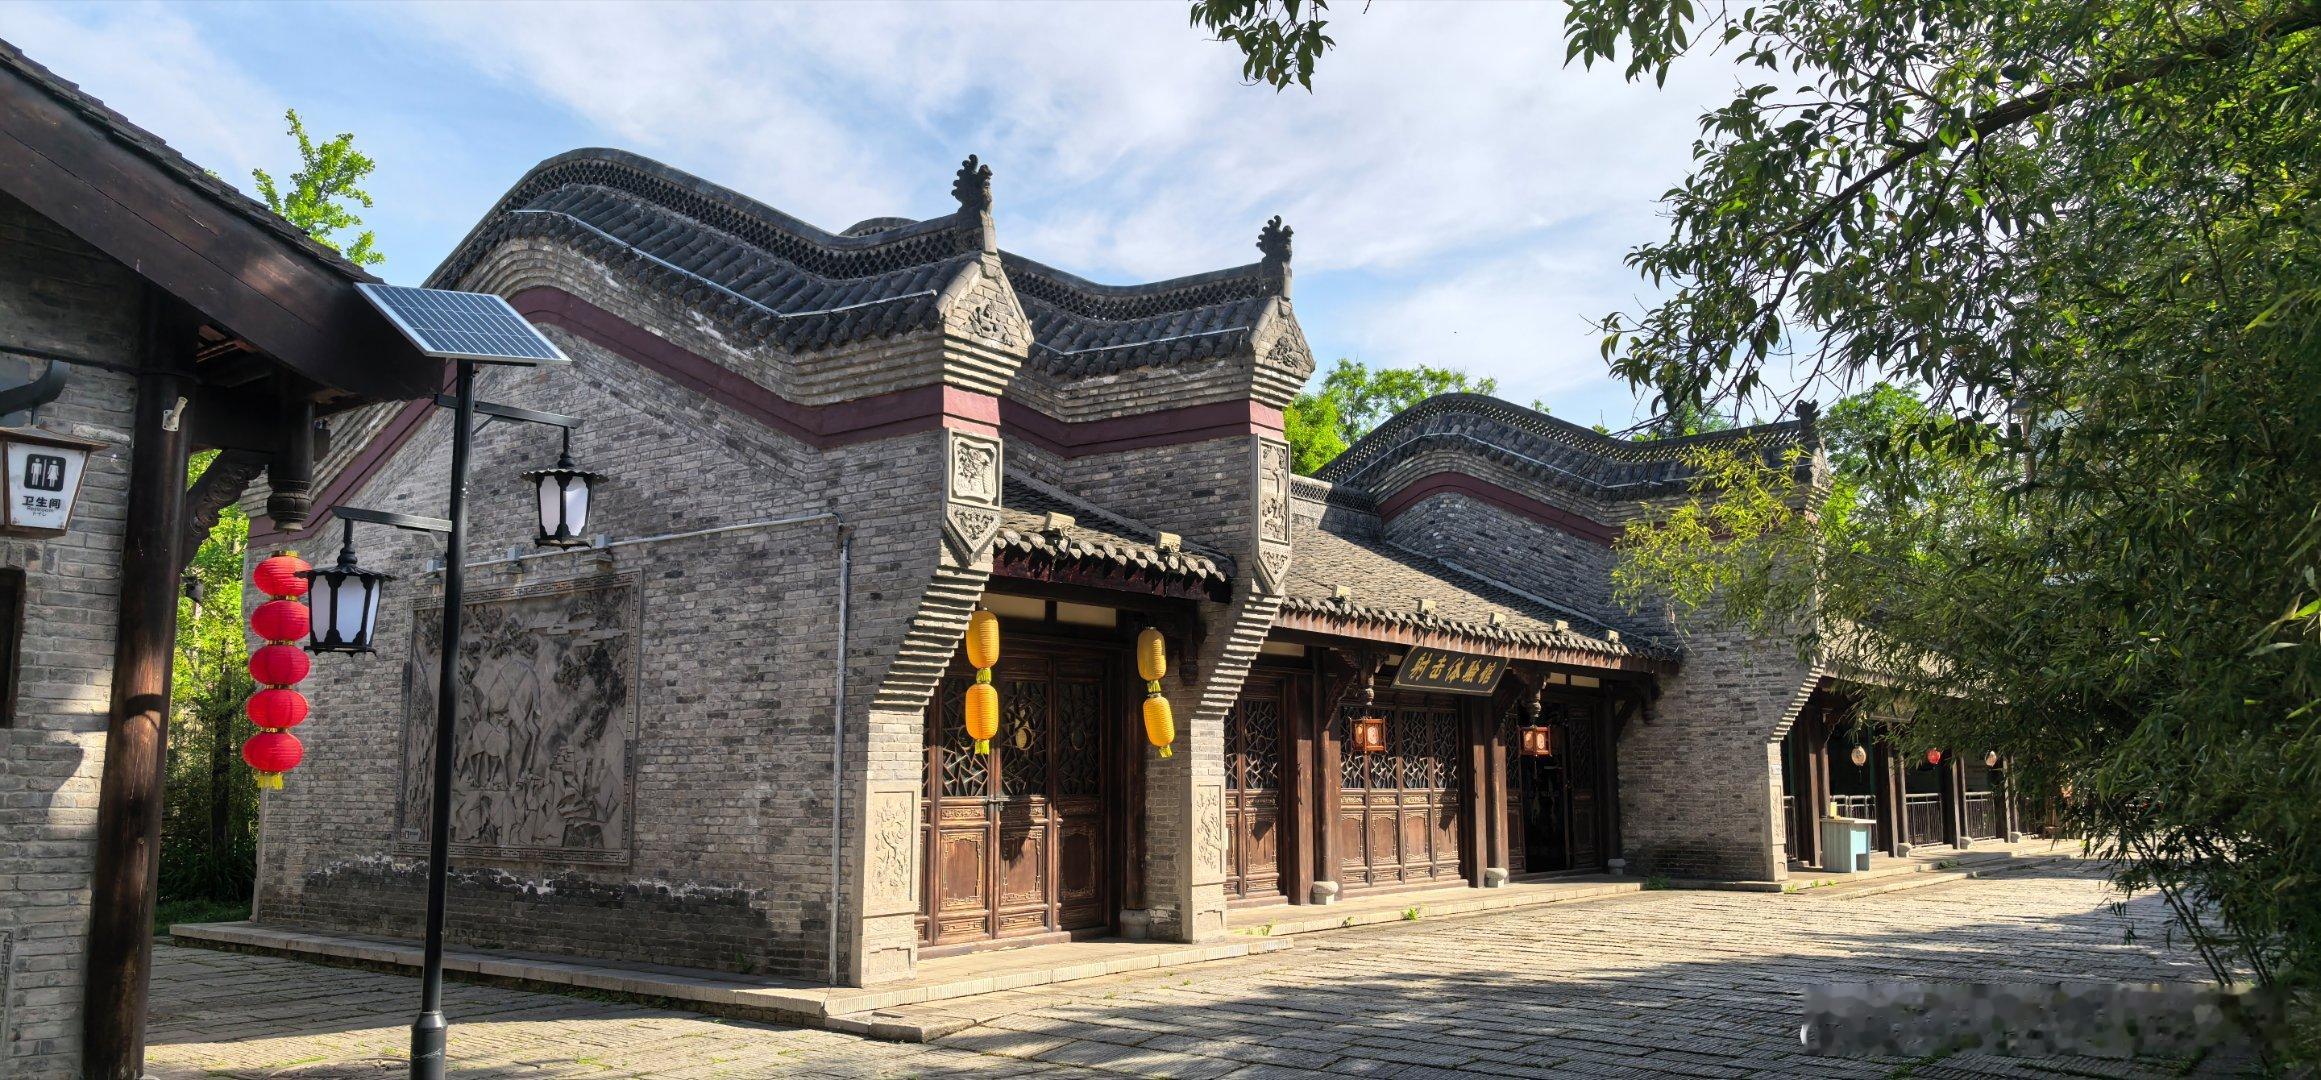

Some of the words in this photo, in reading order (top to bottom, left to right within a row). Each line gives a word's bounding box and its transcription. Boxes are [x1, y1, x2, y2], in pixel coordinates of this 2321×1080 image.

[22, 495, 61, 509] 卫生间
[1408, 652, 1497, 685] 射击体验馆
